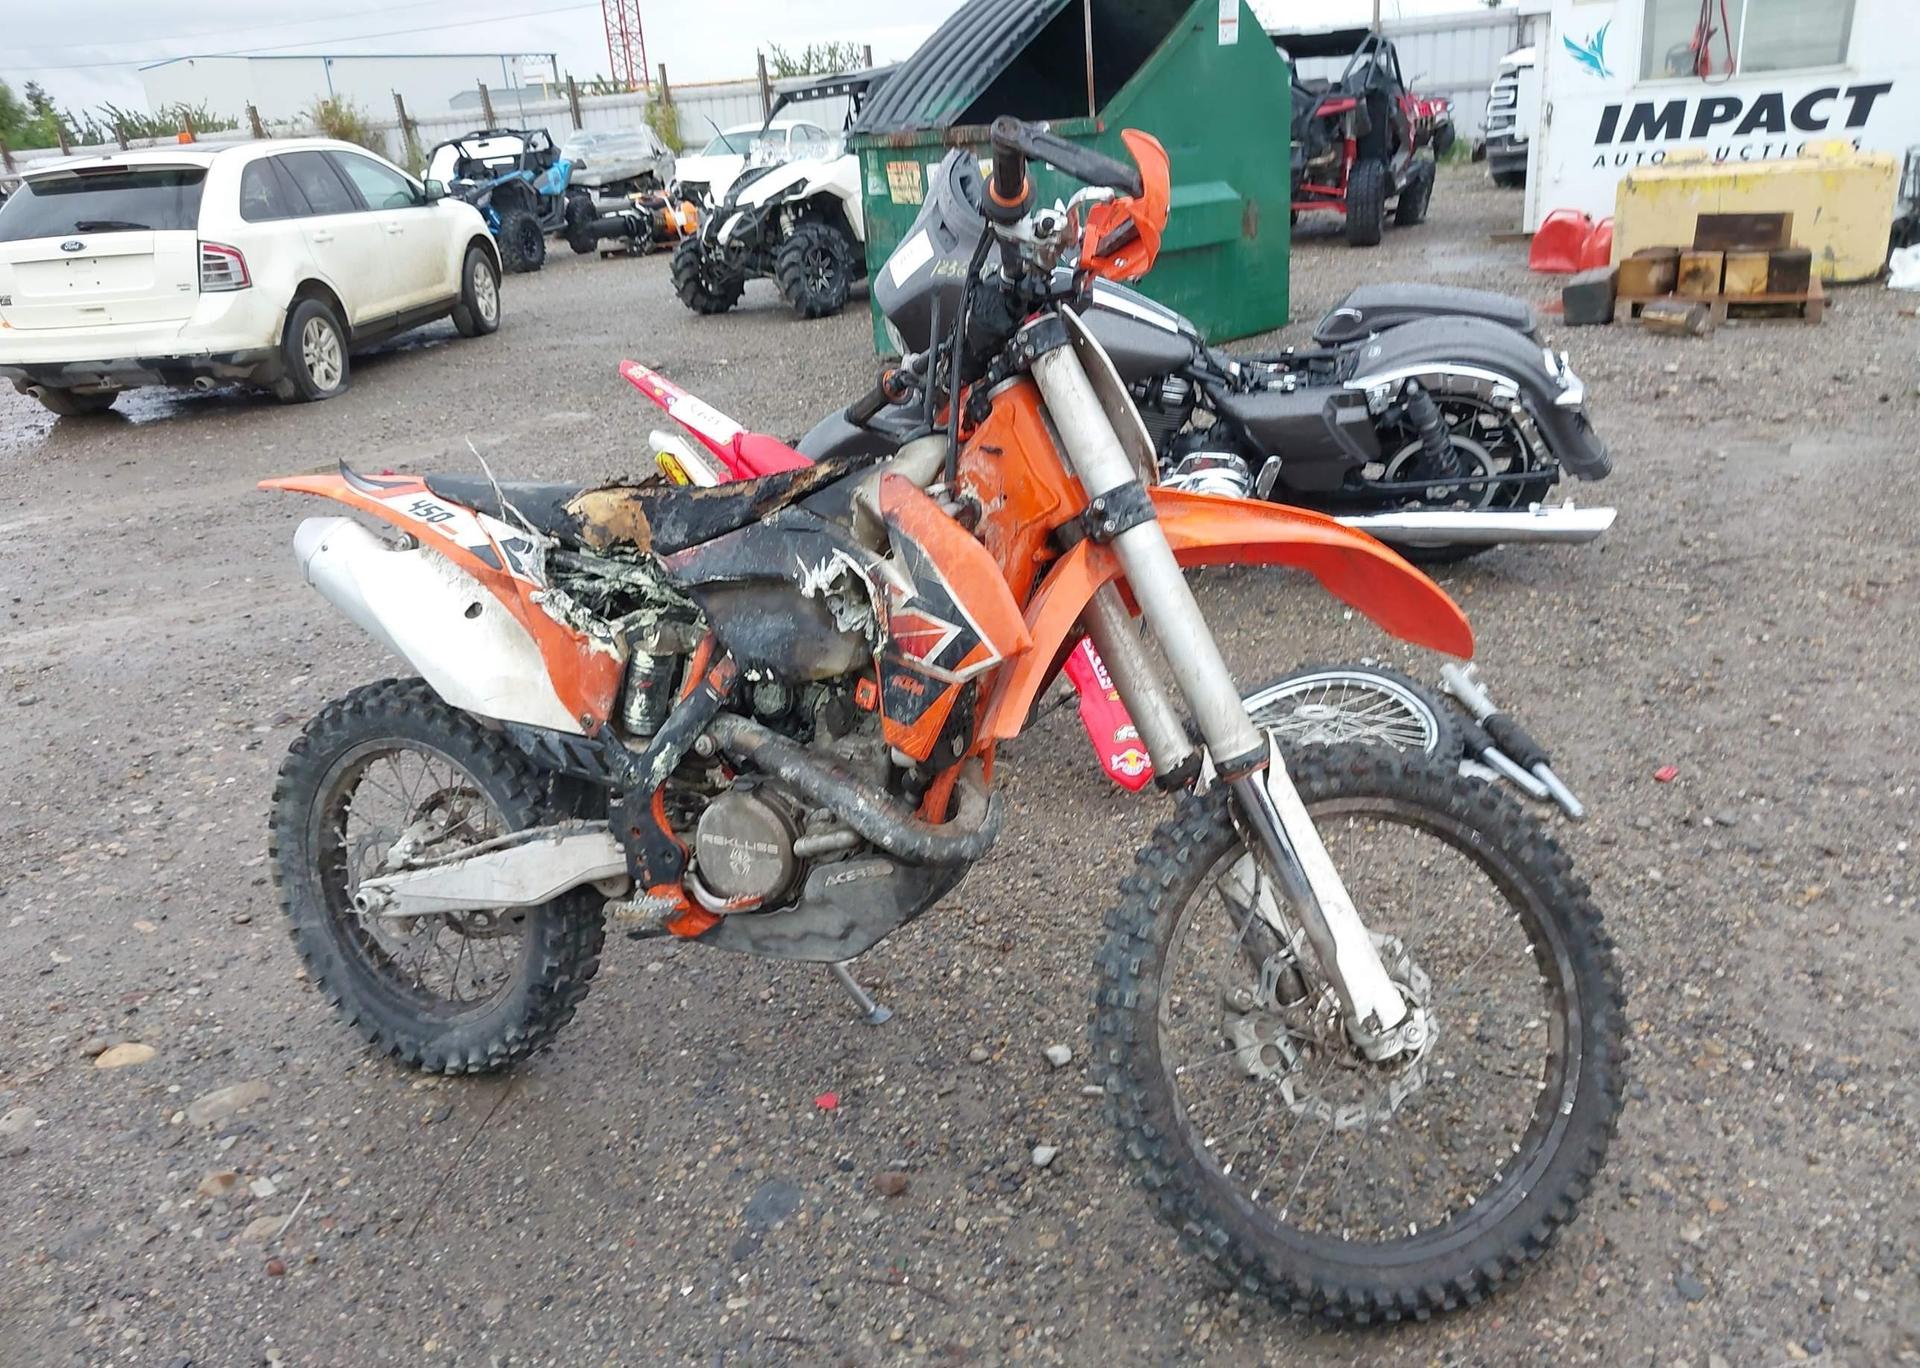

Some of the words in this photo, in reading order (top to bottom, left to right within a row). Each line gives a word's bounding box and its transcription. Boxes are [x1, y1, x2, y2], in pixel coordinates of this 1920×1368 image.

[1594, 82, 1893, 145] IMPACT
[1592, 150, 1667, 169] AUTO
[408, 499, 456, 523] 450
